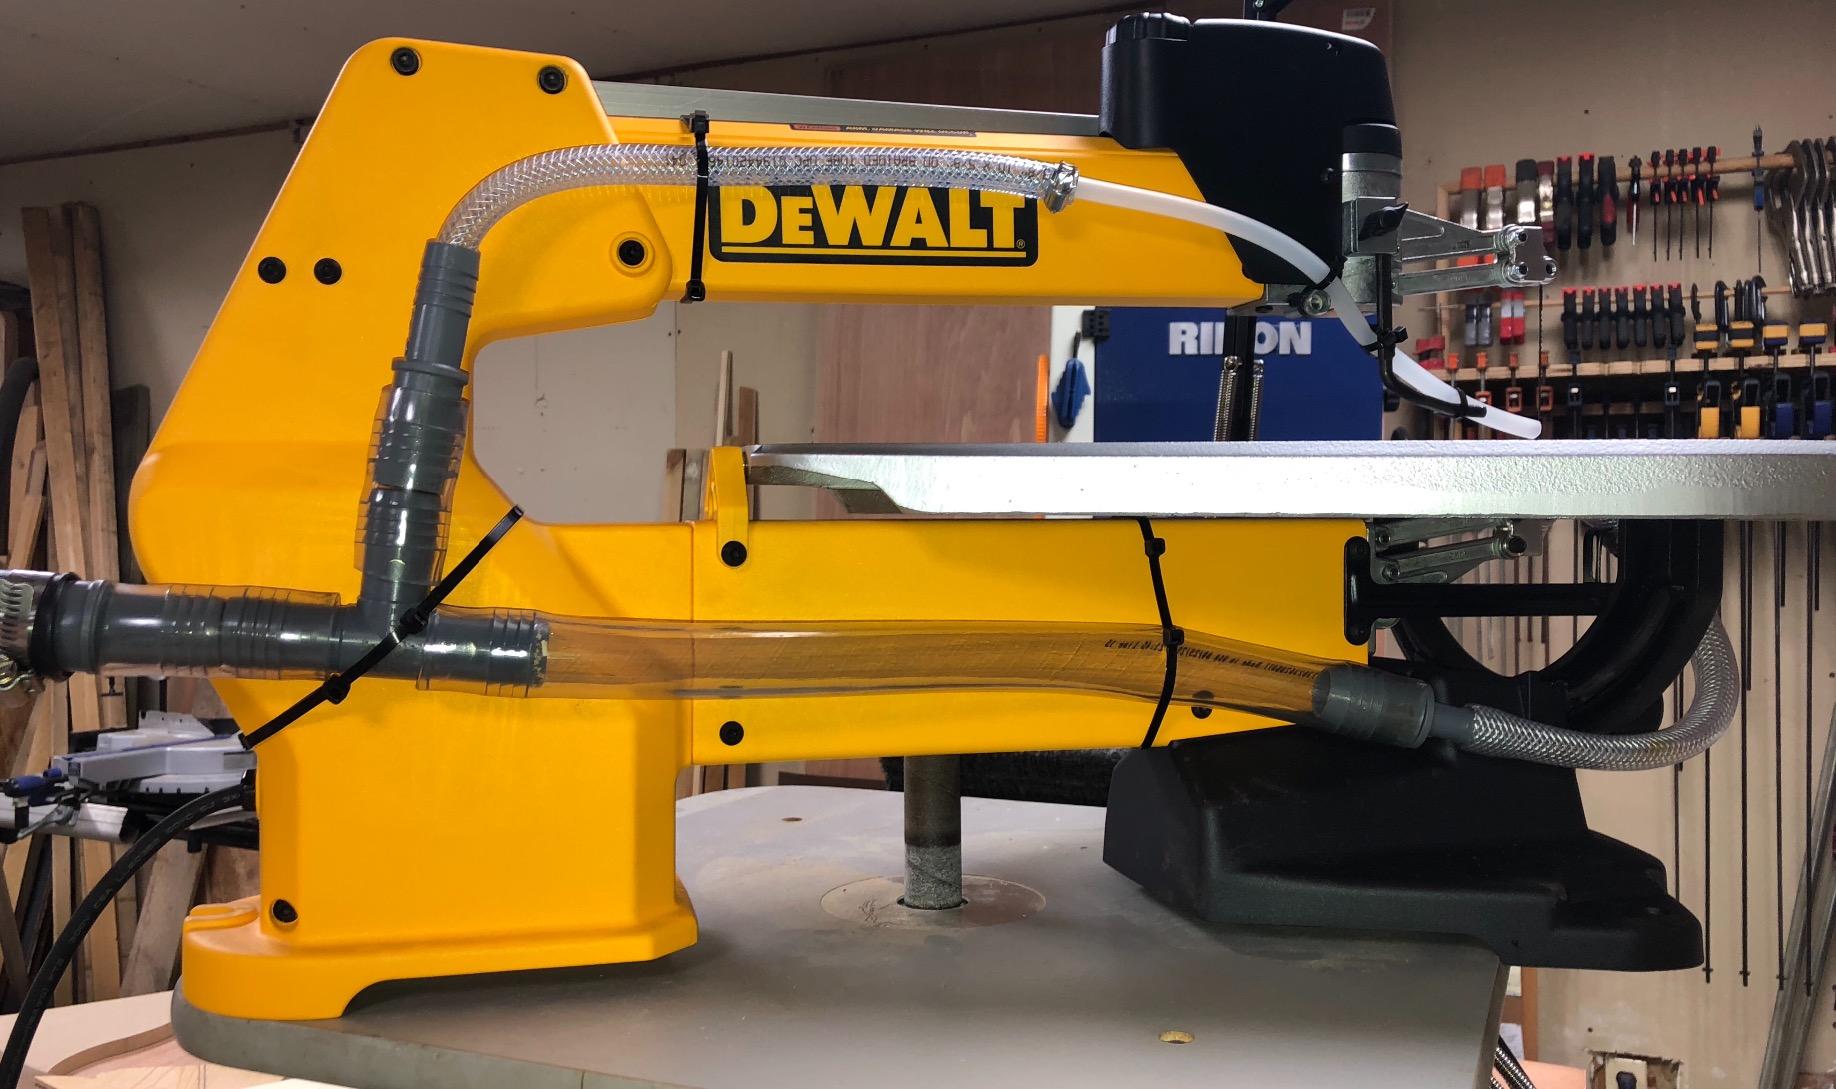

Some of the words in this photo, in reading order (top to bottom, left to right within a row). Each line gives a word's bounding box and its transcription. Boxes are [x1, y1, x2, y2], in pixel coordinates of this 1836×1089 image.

[826, 154, 855, 168] TUBE
[863, 155, 916, 169] BRAIDED
[719, 184, 1026, 249] DEWALT
[1169, 321, 1312, 355] RION
